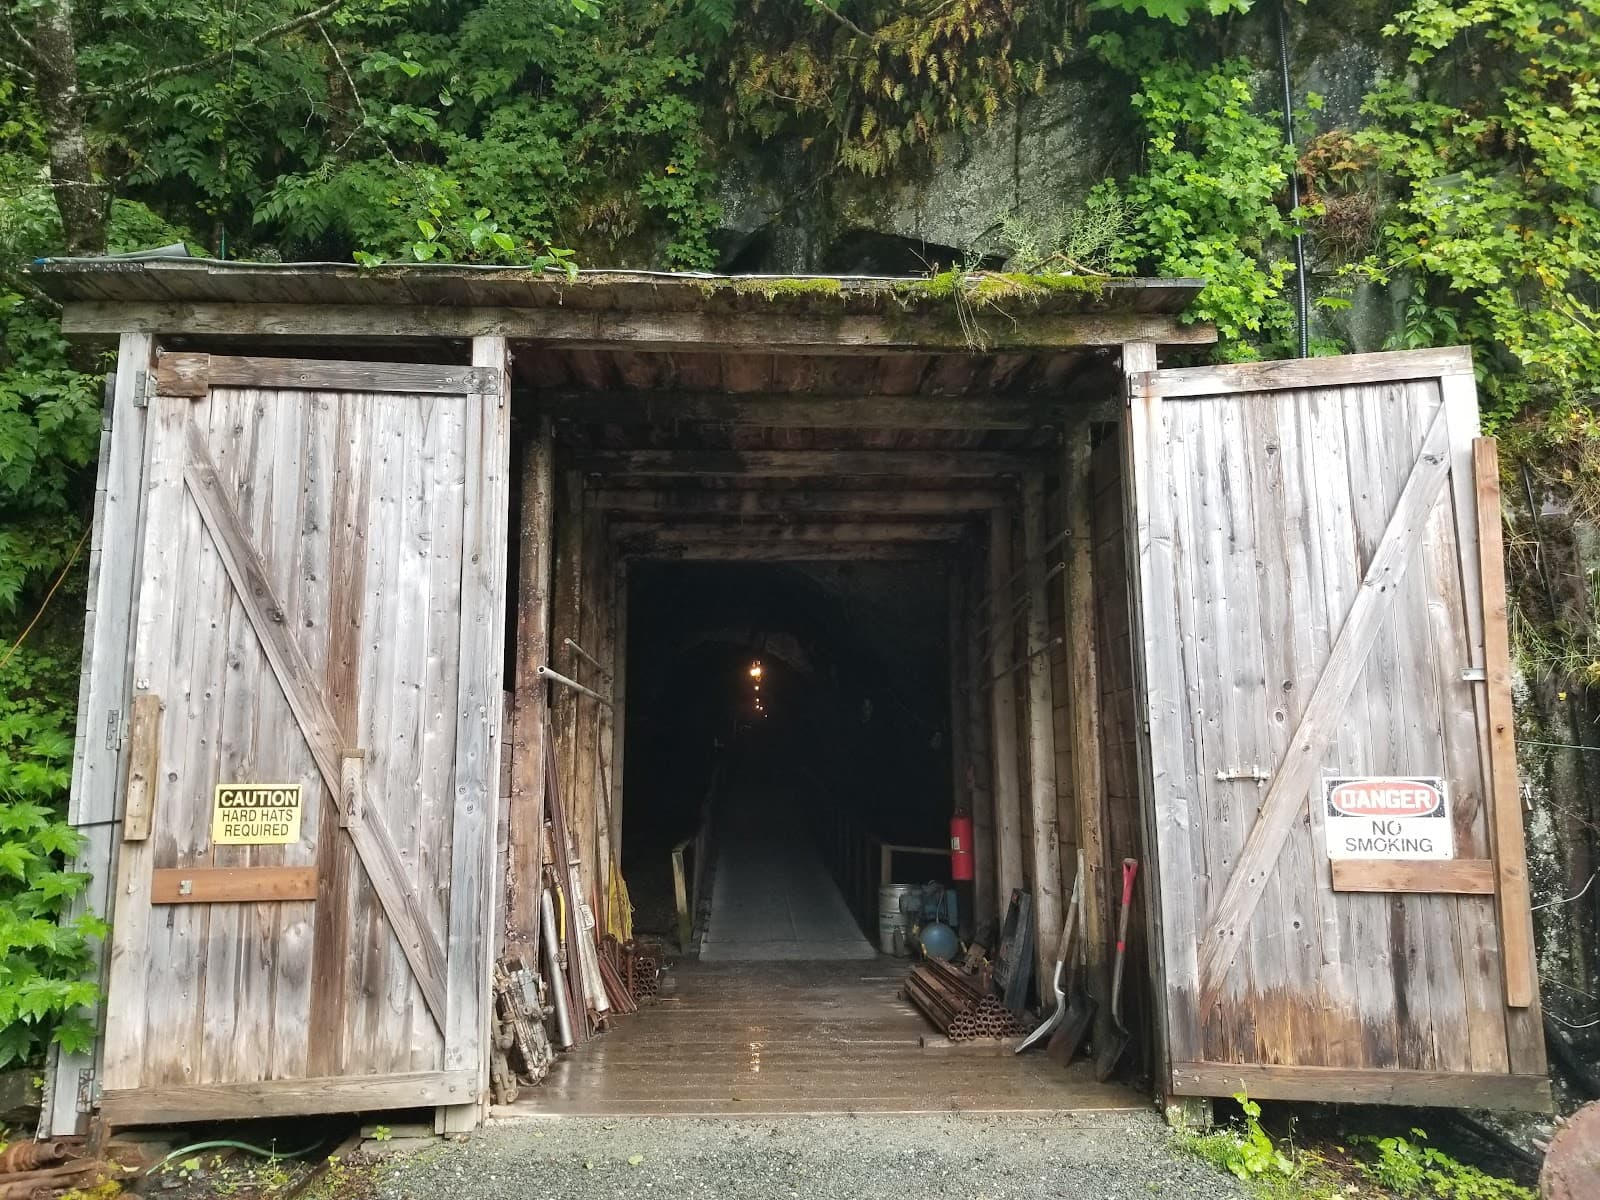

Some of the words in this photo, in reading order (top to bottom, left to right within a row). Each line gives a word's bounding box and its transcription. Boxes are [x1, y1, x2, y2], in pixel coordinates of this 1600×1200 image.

[220, 790, 297, 806] CAUTION
[1341, 789, 1431, 809] DANGER
[222, 809, 257, 822] HARD
[261, 809, 293, 821] HATS
[224, 823, 289, 837] REQUIRED
[1372, 820, 1402, 836] NO
[1345, 837, 1433, 853] SMOKING
